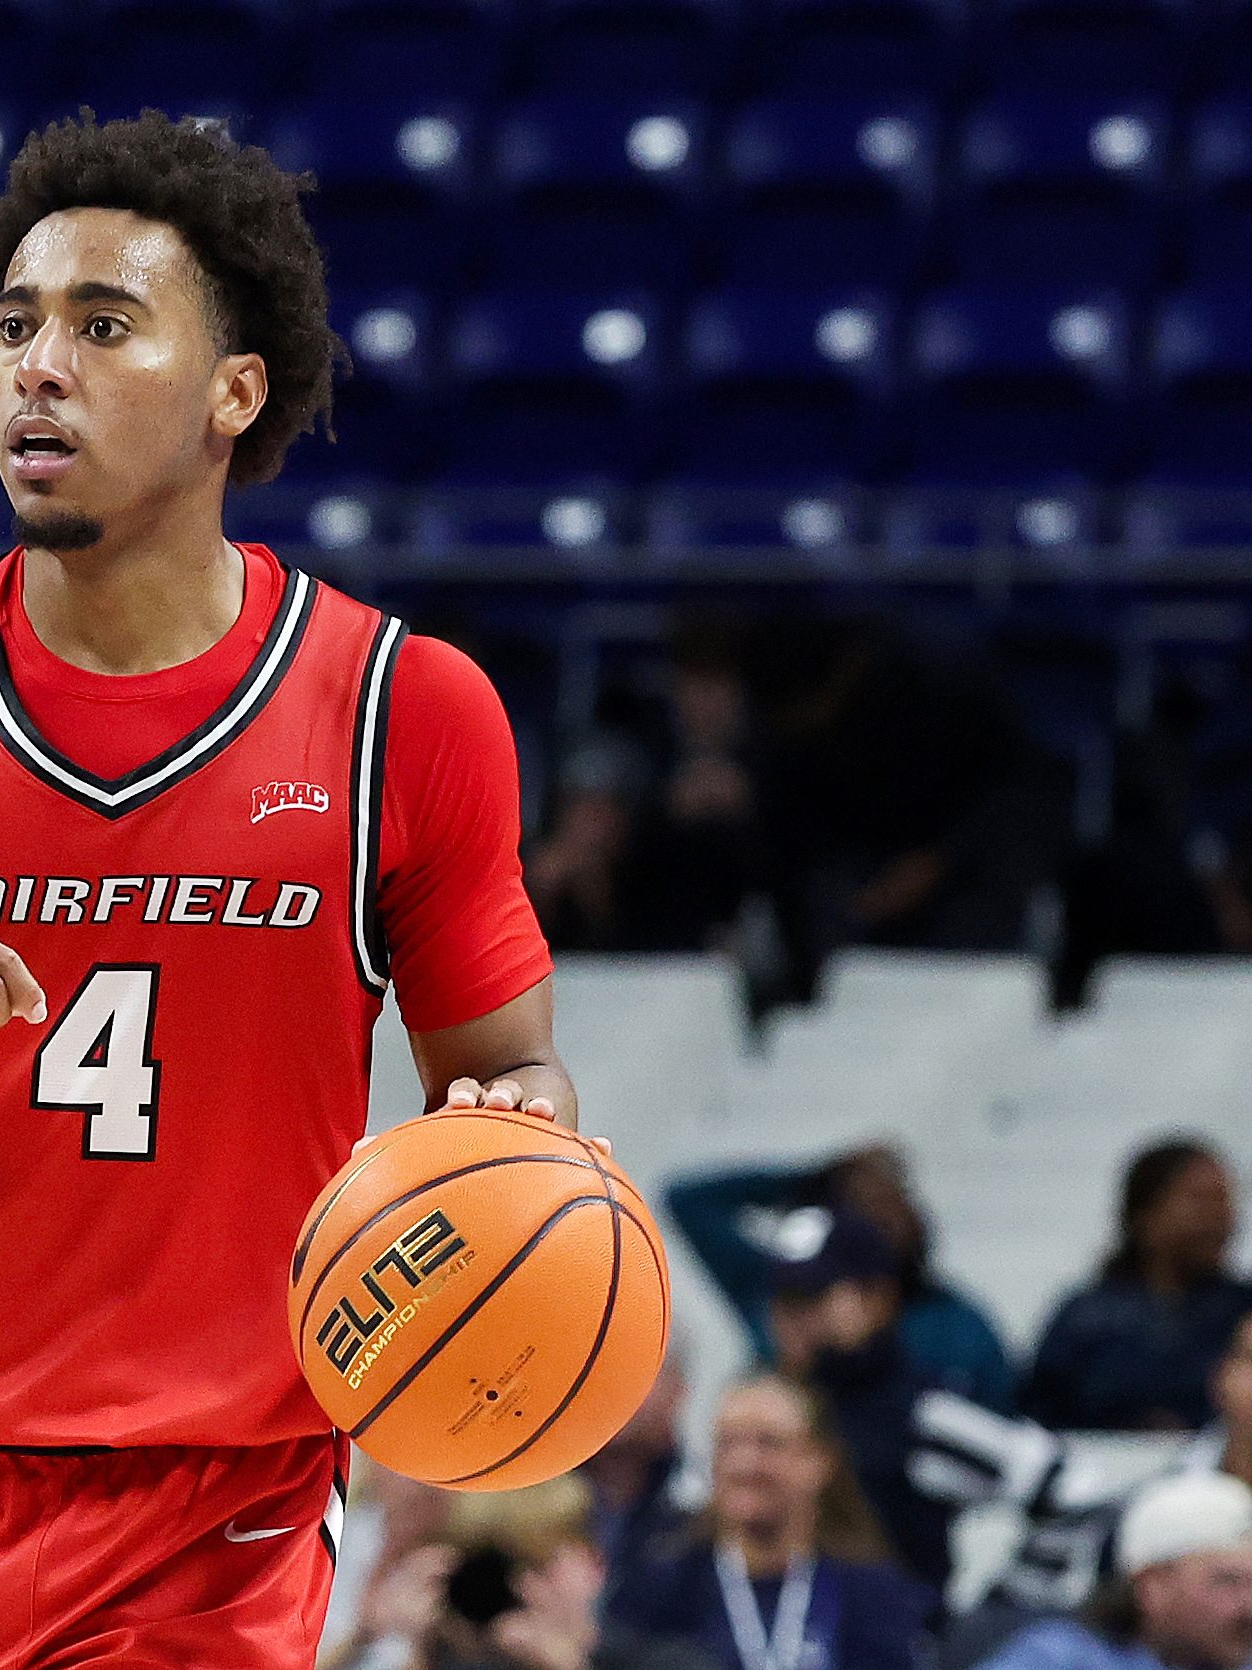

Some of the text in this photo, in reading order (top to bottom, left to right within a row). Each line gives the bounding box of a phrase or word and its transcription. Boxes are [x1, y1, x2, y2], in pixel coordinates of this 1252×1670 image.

[251, 781, 329, 824] MAAC
[30, 962, 161, 1162] 4
[315, 1207, 468, 1378] ELITE
[347, 1249, 477, 1391] CHAMPIONHIP
